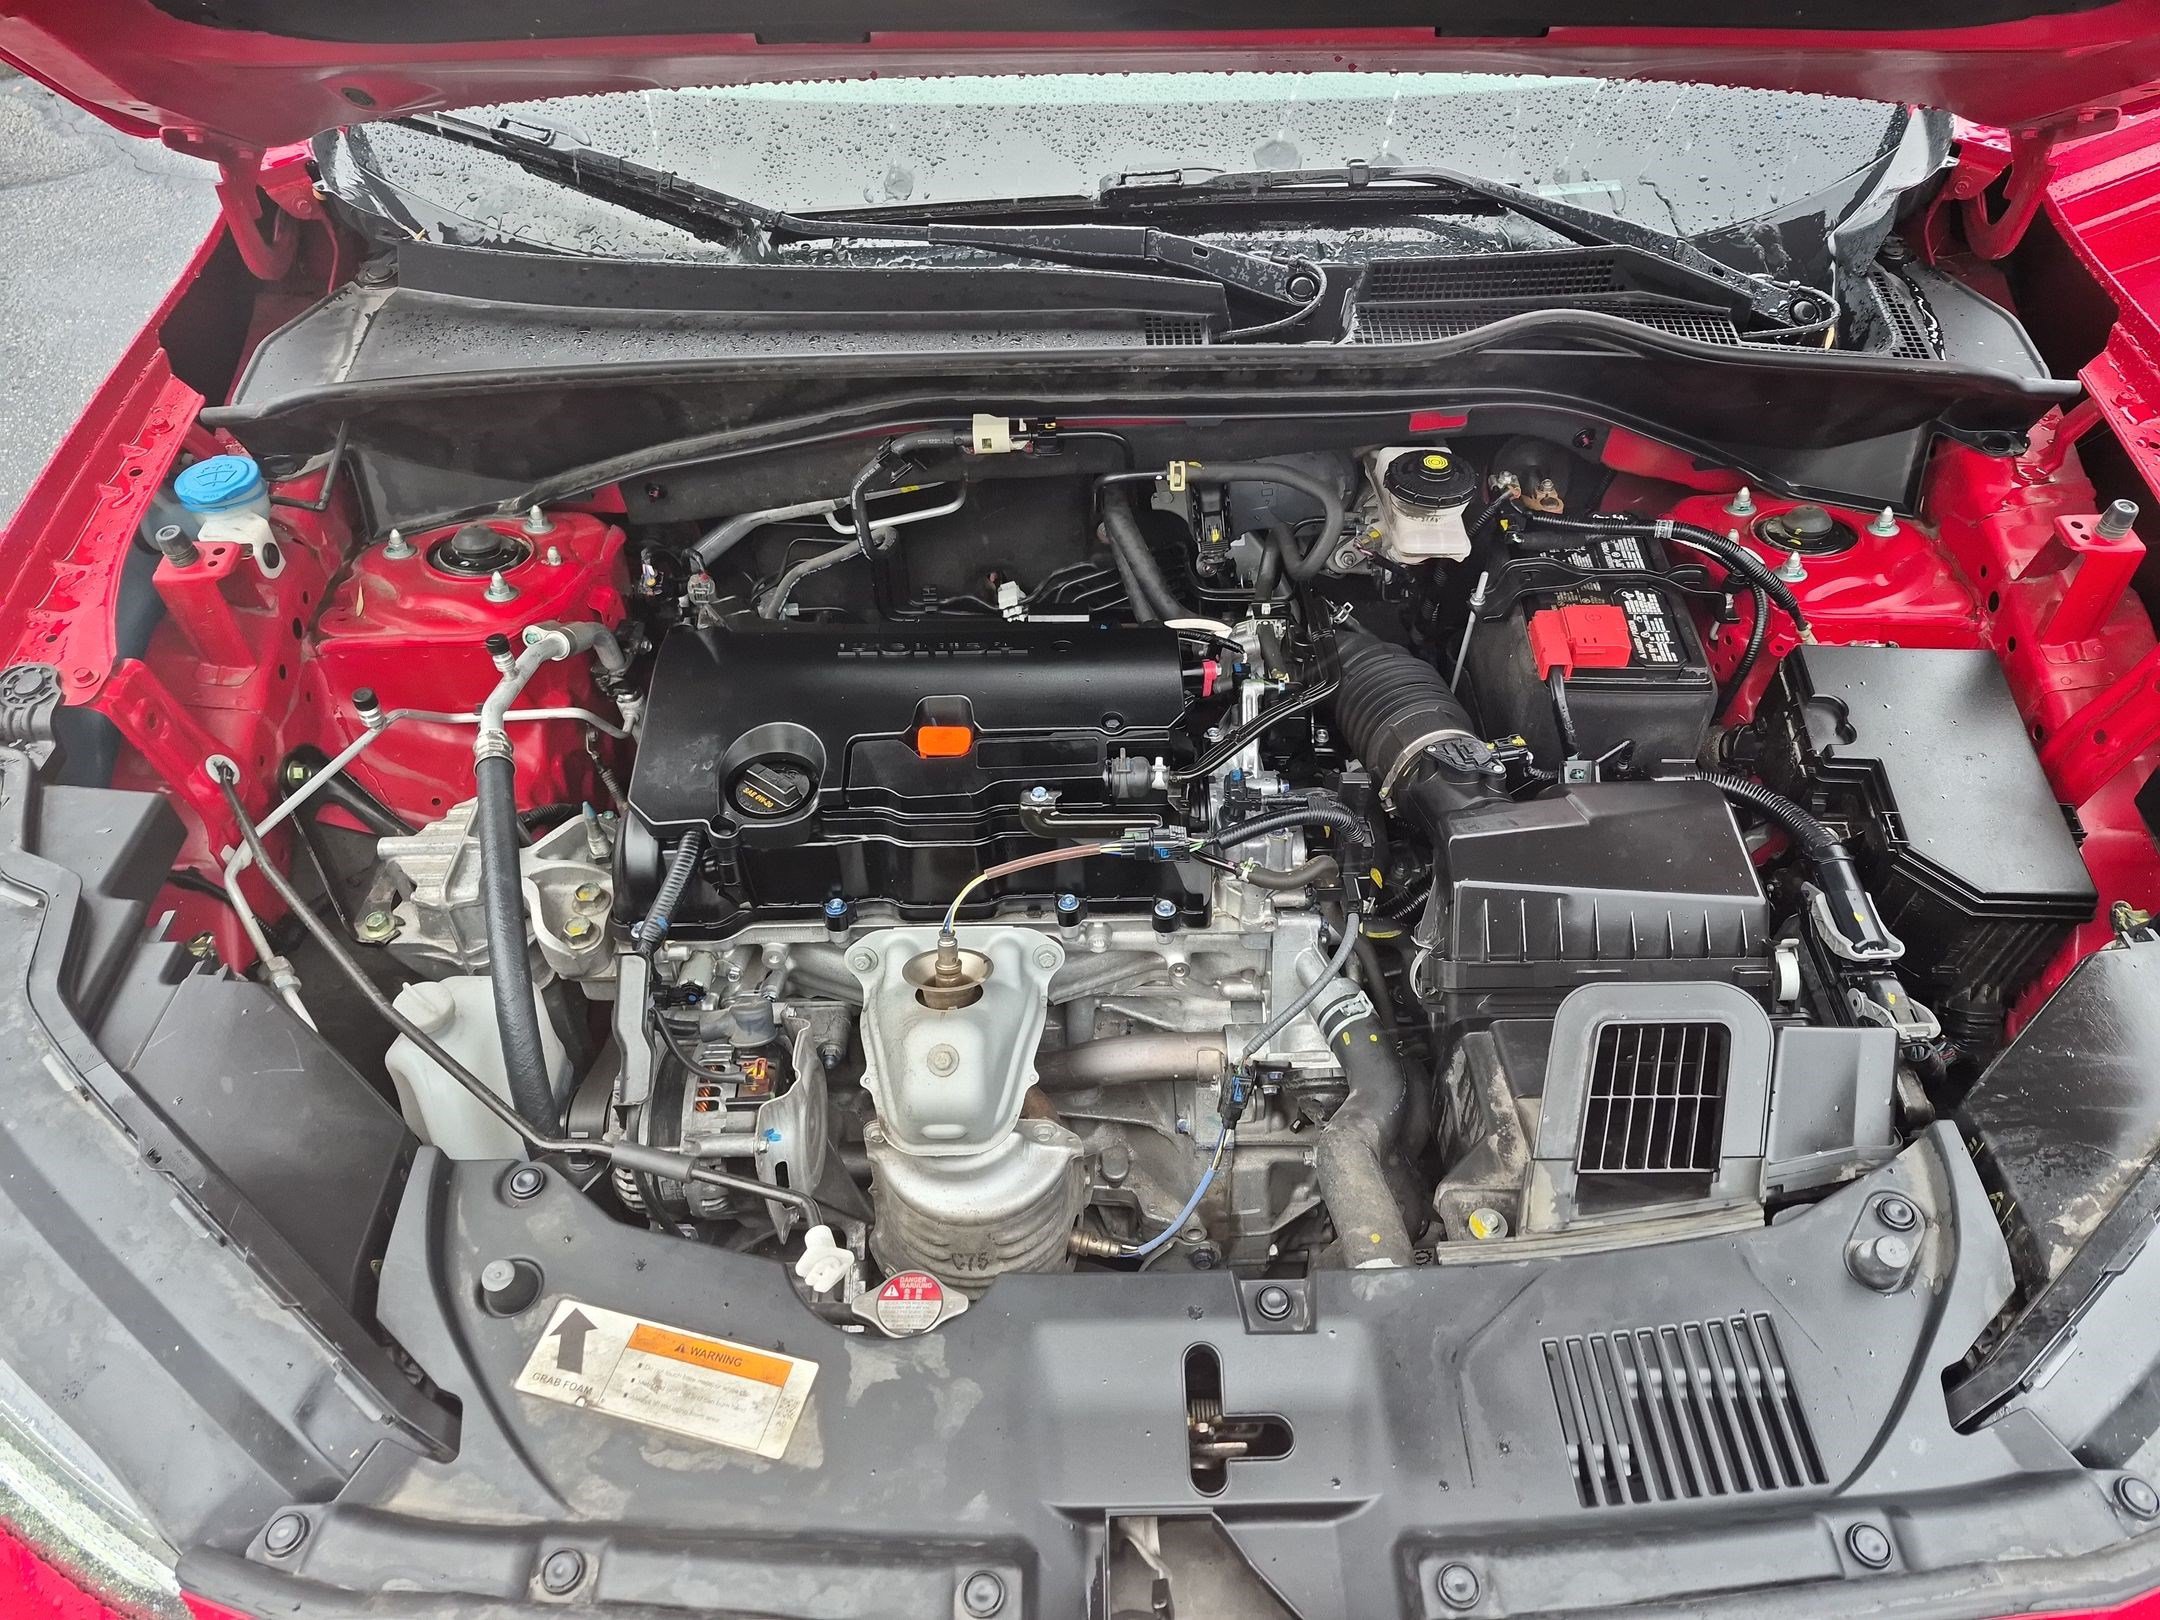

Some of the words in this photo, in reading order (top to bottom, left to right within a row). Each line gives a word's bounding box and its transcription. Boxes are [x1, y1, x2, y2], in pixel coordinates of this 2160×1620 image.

[755, 795, 774, 808] 0W-20
[688, 1345, 743, 1368] WARNING
[532, 1371, 561, 1391] GRAB
[562, 1378, 594, 1396] FOAM
